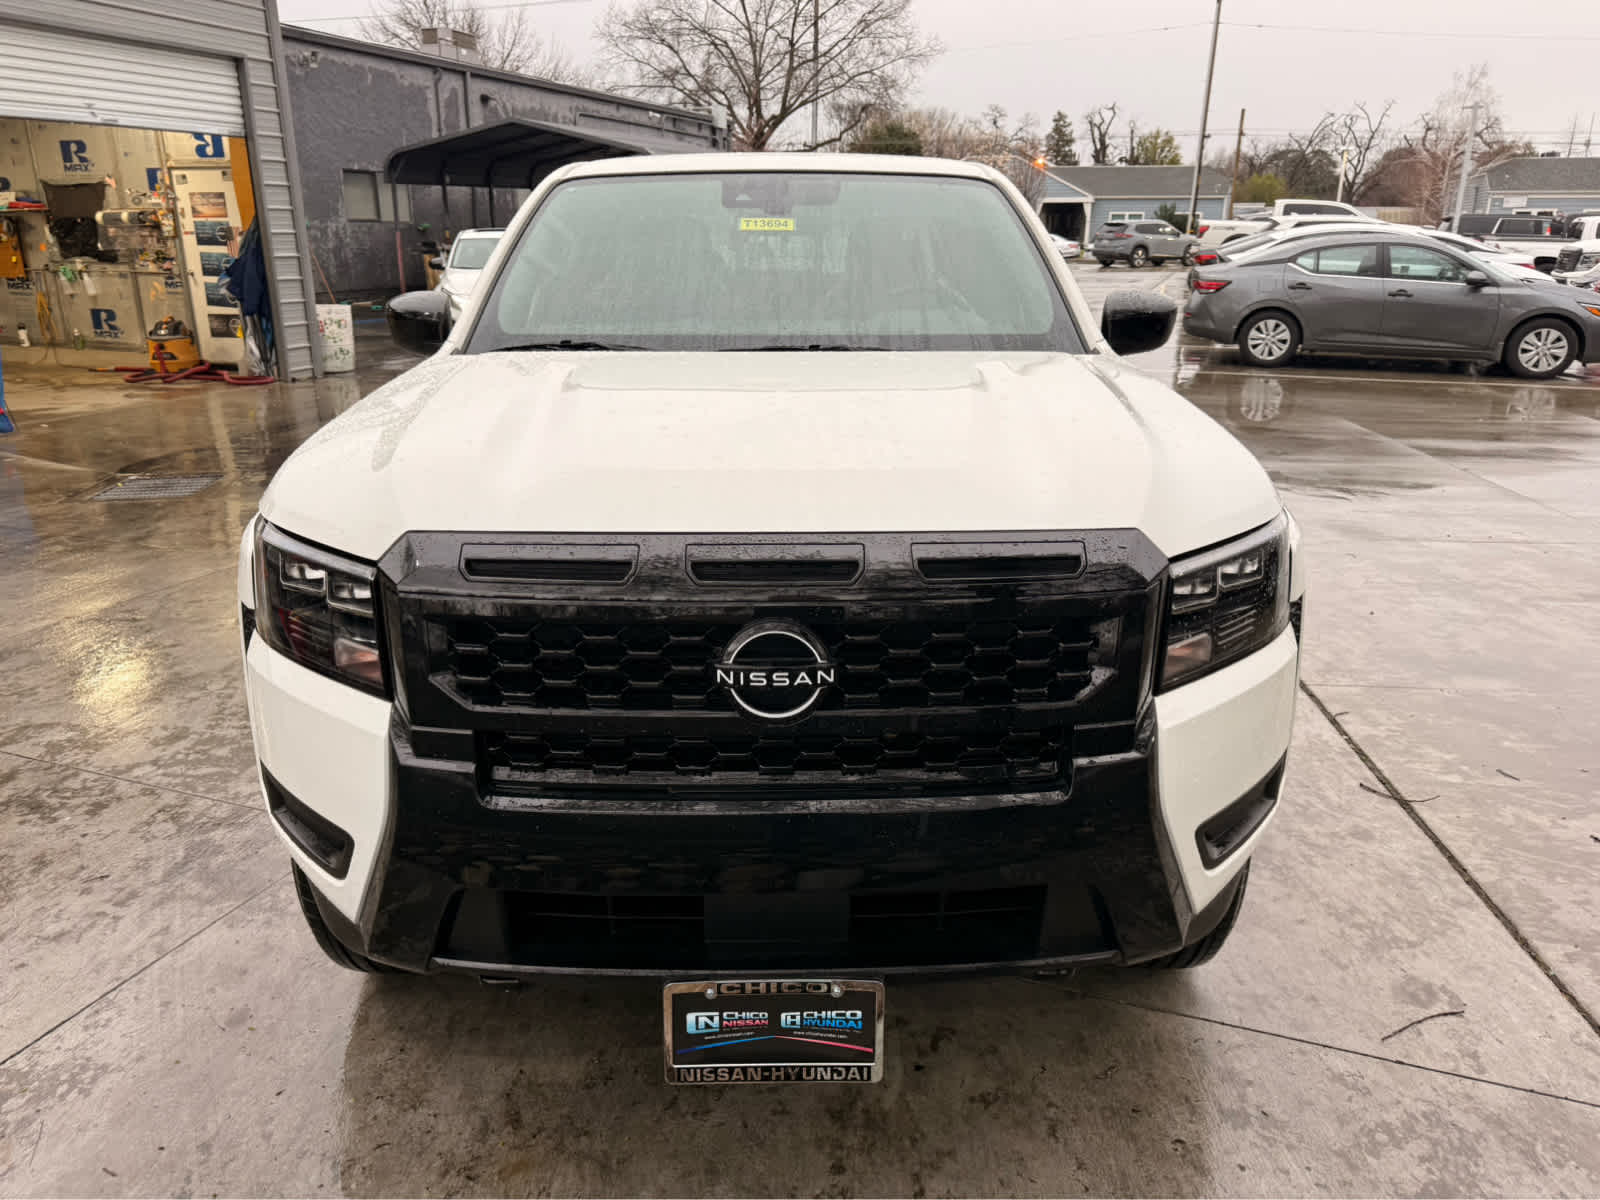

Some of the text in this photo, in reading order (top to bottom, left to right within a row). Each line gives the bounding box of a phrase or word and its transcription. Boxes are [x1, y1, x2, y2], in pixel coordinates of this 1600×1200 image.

[59, 139, 89, 163] R
[743, 219, 789, 228] T13694
[90, 308, 120, 331] R
[716, 668, 835, 686] NISSAN
[720, 982, 828, 994] CHICO
[722, 1011, 769, 1020] CHICO
[803, 1010, 862, 1020] CHICO
[722, 1019, 769, 1028] NISSAN
[803, 1018, 863, 1030] HYUNDAI
[679, 1066, 868, 1082] NISSAN-HYUNDAI
